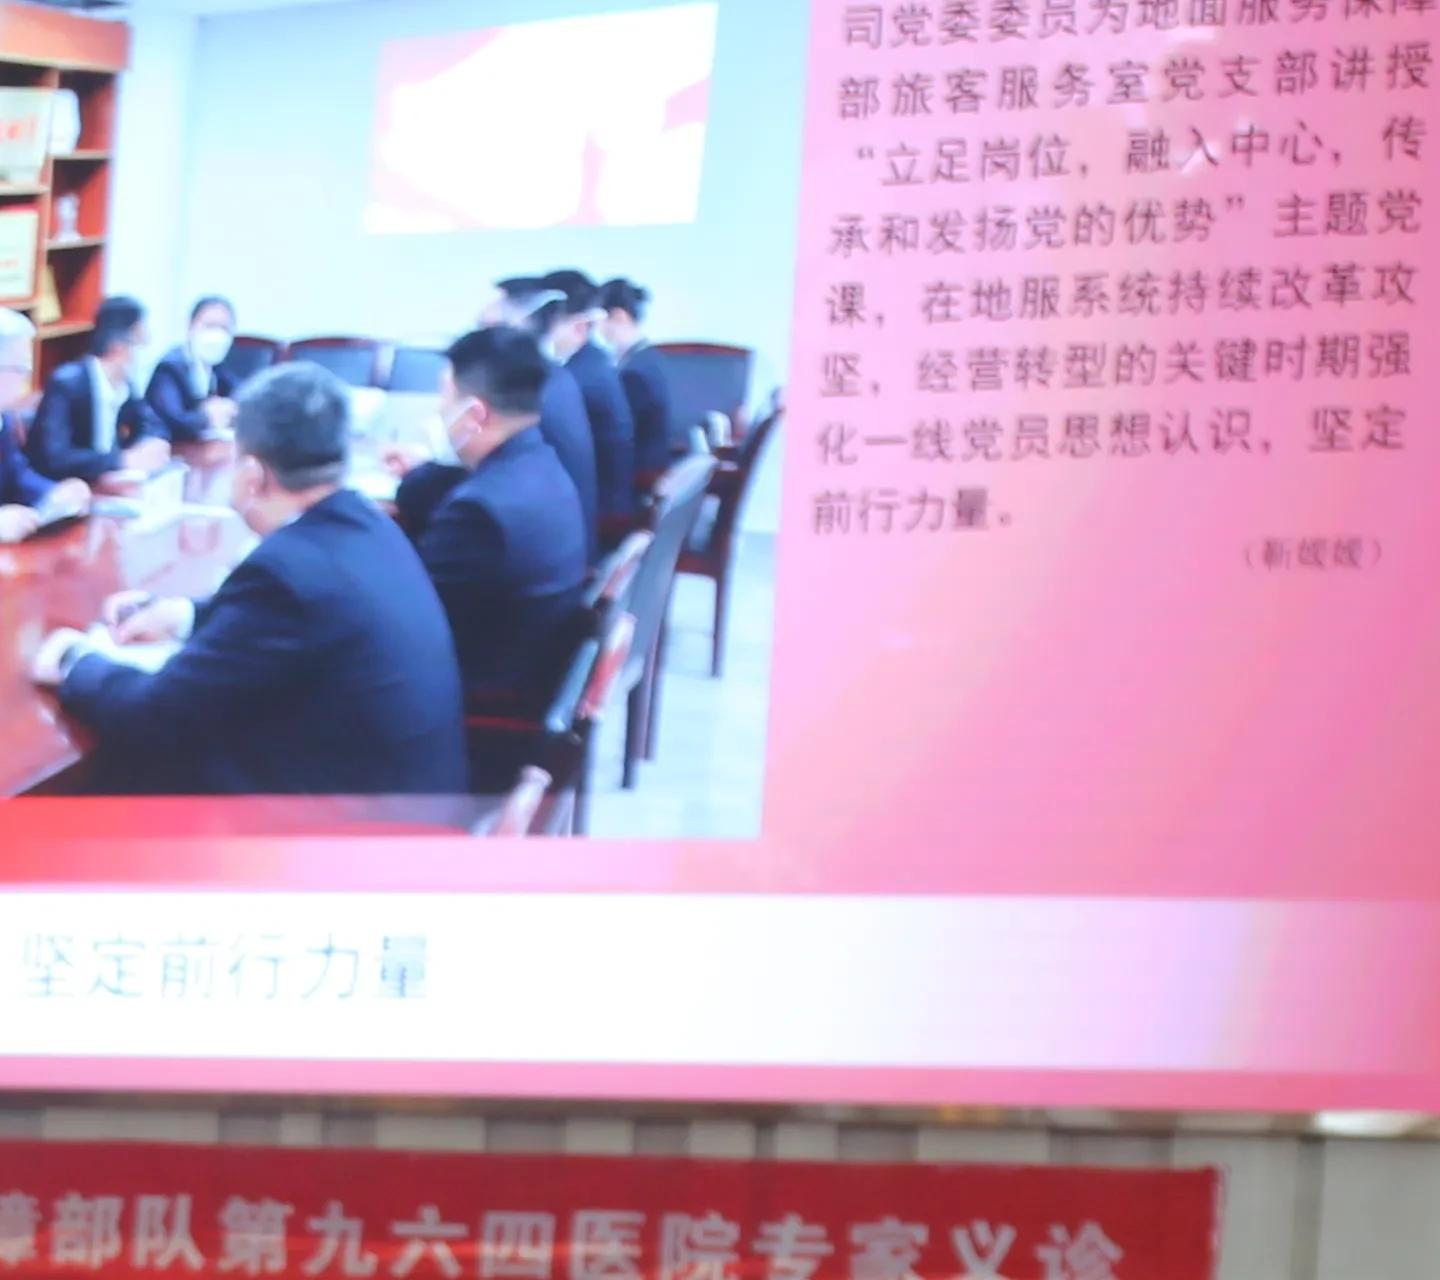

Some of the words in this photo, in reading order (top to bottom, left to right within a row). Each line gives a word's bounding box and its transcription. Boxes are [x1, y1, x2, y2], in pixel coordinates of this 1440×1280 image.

[837, 41, 1434, 119] 部旅客服务室党支部讲授
[22, 932, 427, 999] 坚定前行力量
